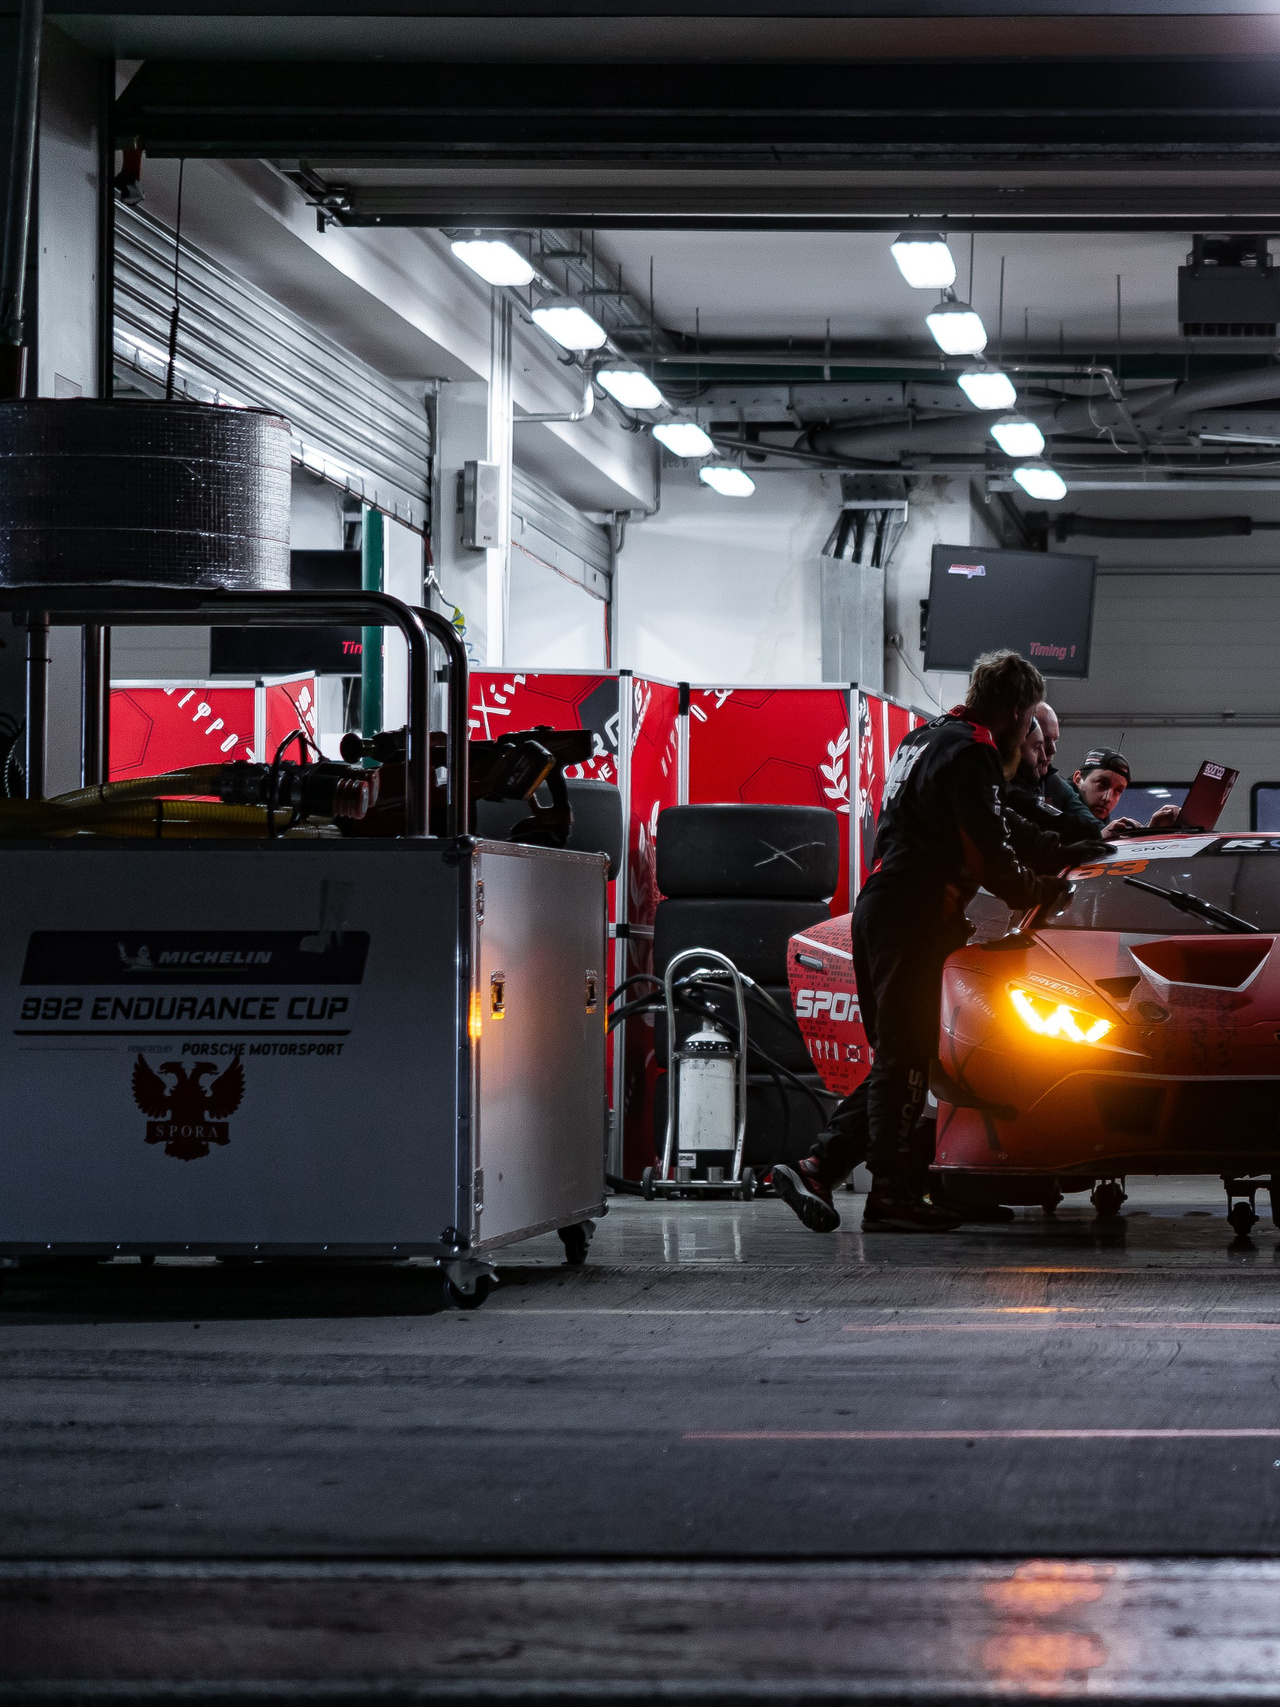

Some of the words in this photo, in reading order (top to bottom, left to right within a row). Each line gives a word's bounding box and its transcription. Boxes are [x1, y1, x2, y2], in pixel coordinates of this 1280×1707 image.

[1030, 642, 1067, 660] Timing
[1070, 645, 1076, 658] 1
[1204, 763, 1226, 777] sparco
[1067, 859, 1150, 881] 63
[159, 951, 273, 965] MICHELIN
[21, 997, 84, 1020] 992
[90, 997, 279, 1020] ENDURANCE
[287, 997, 349, 1020] CUP
[796, 989, 863, 1023] SPOR
[182, 1043, 246, 1056] PORSCHE
[249, 1043, 344, 1056] MOTORSPORT
[155, 1124, 219, 1139] SPORA
